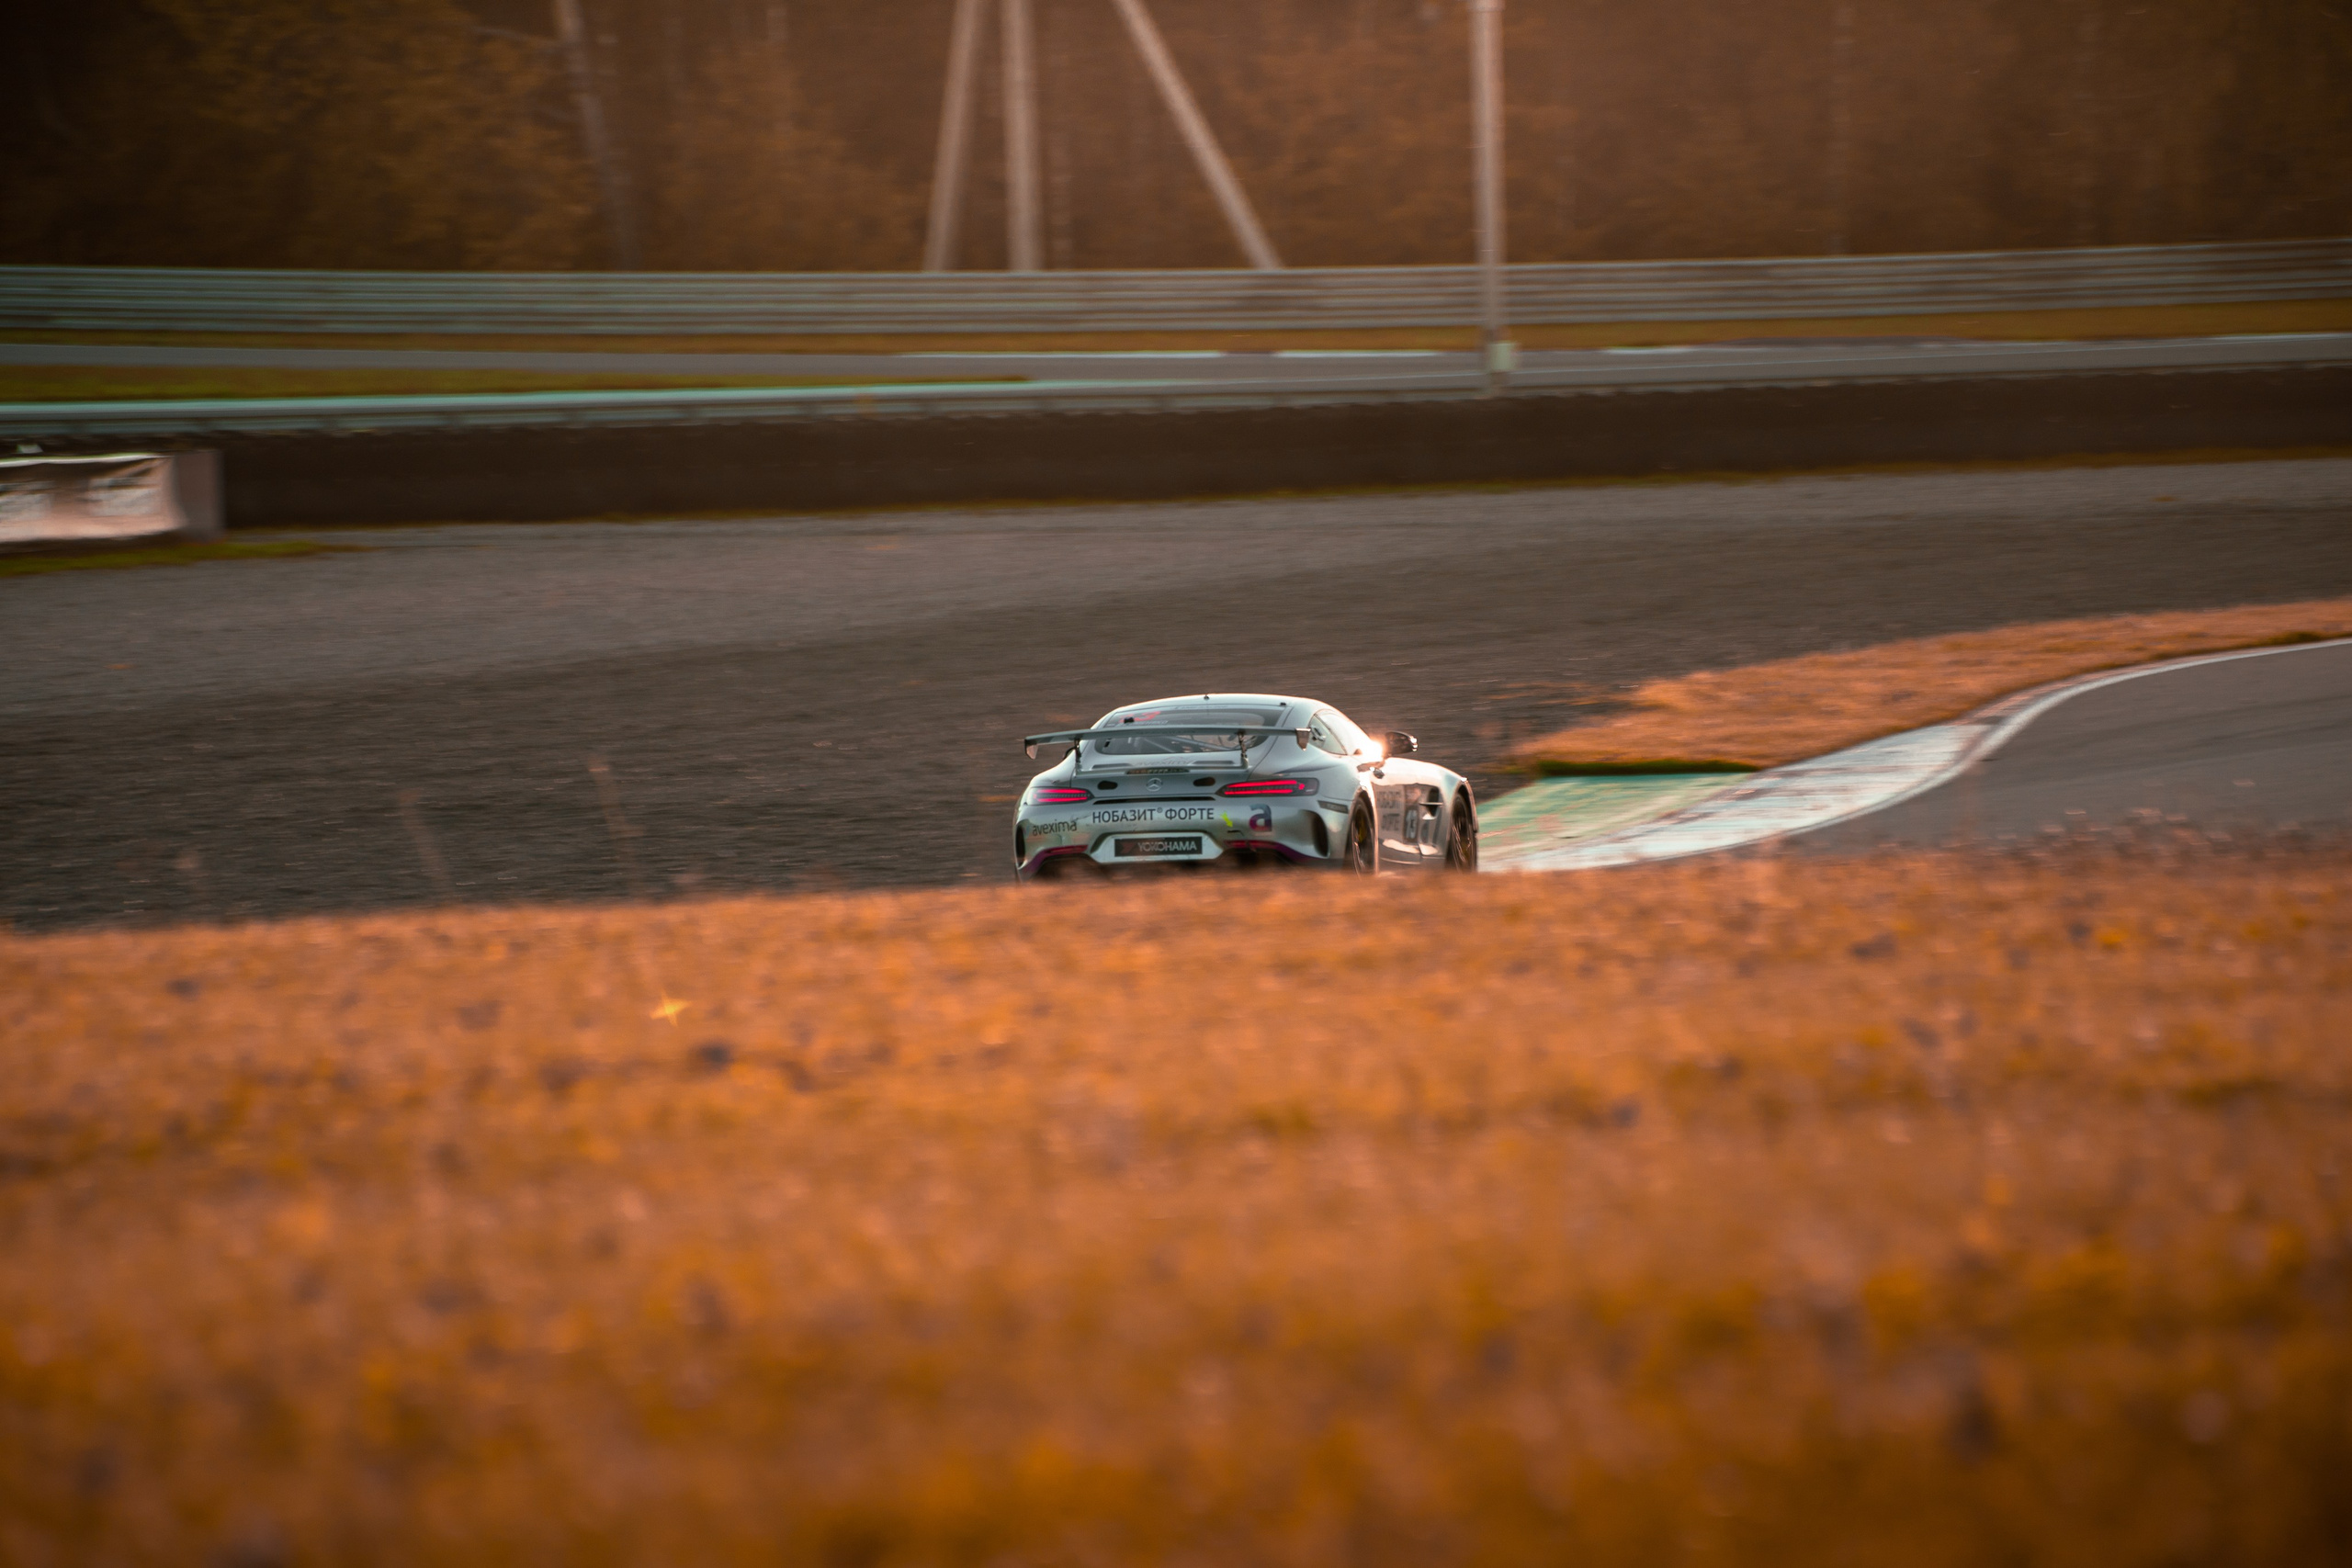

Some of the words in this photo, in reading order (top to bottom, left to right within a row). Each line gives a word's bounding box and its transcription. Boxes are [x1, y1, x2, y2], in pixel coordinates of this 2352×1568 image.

[1165, 807, 1215, 820] ФОРТЕ
[1250, 803, 1272, 833] a
[1032, 818, 1078, 837] avexima
[1137, 840, 1197, 852] YOKOHAMA
